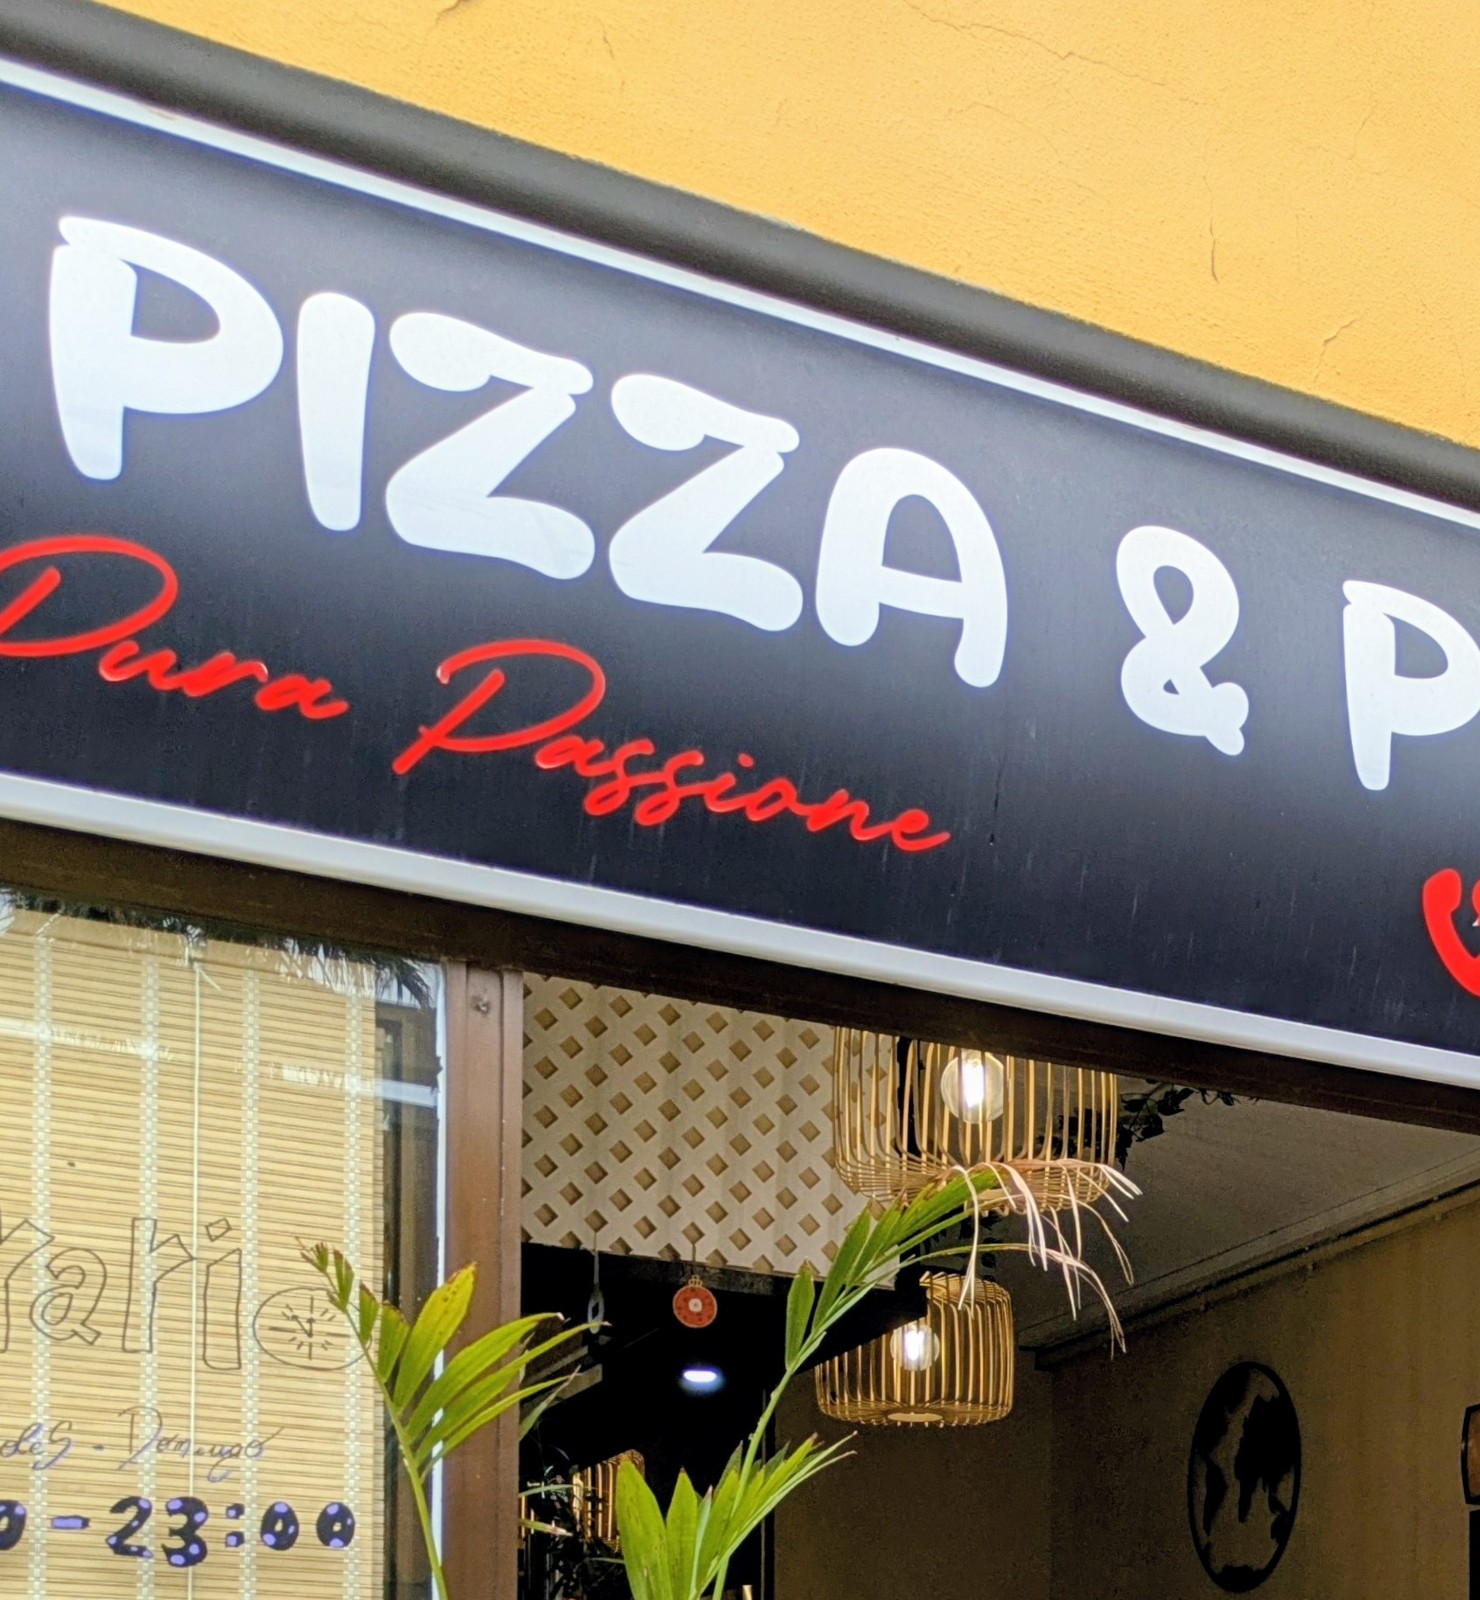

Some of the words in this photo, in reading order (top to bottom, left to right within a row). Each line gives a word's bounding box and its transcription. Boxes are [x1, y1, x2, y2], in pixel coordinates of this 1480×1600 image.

[0, 534, 349, 720] Pura
[394, 638, 952, 852] Passione
[49, 216, 1007, 688] PIZZA
[1115, 525, 1250, 756] &
